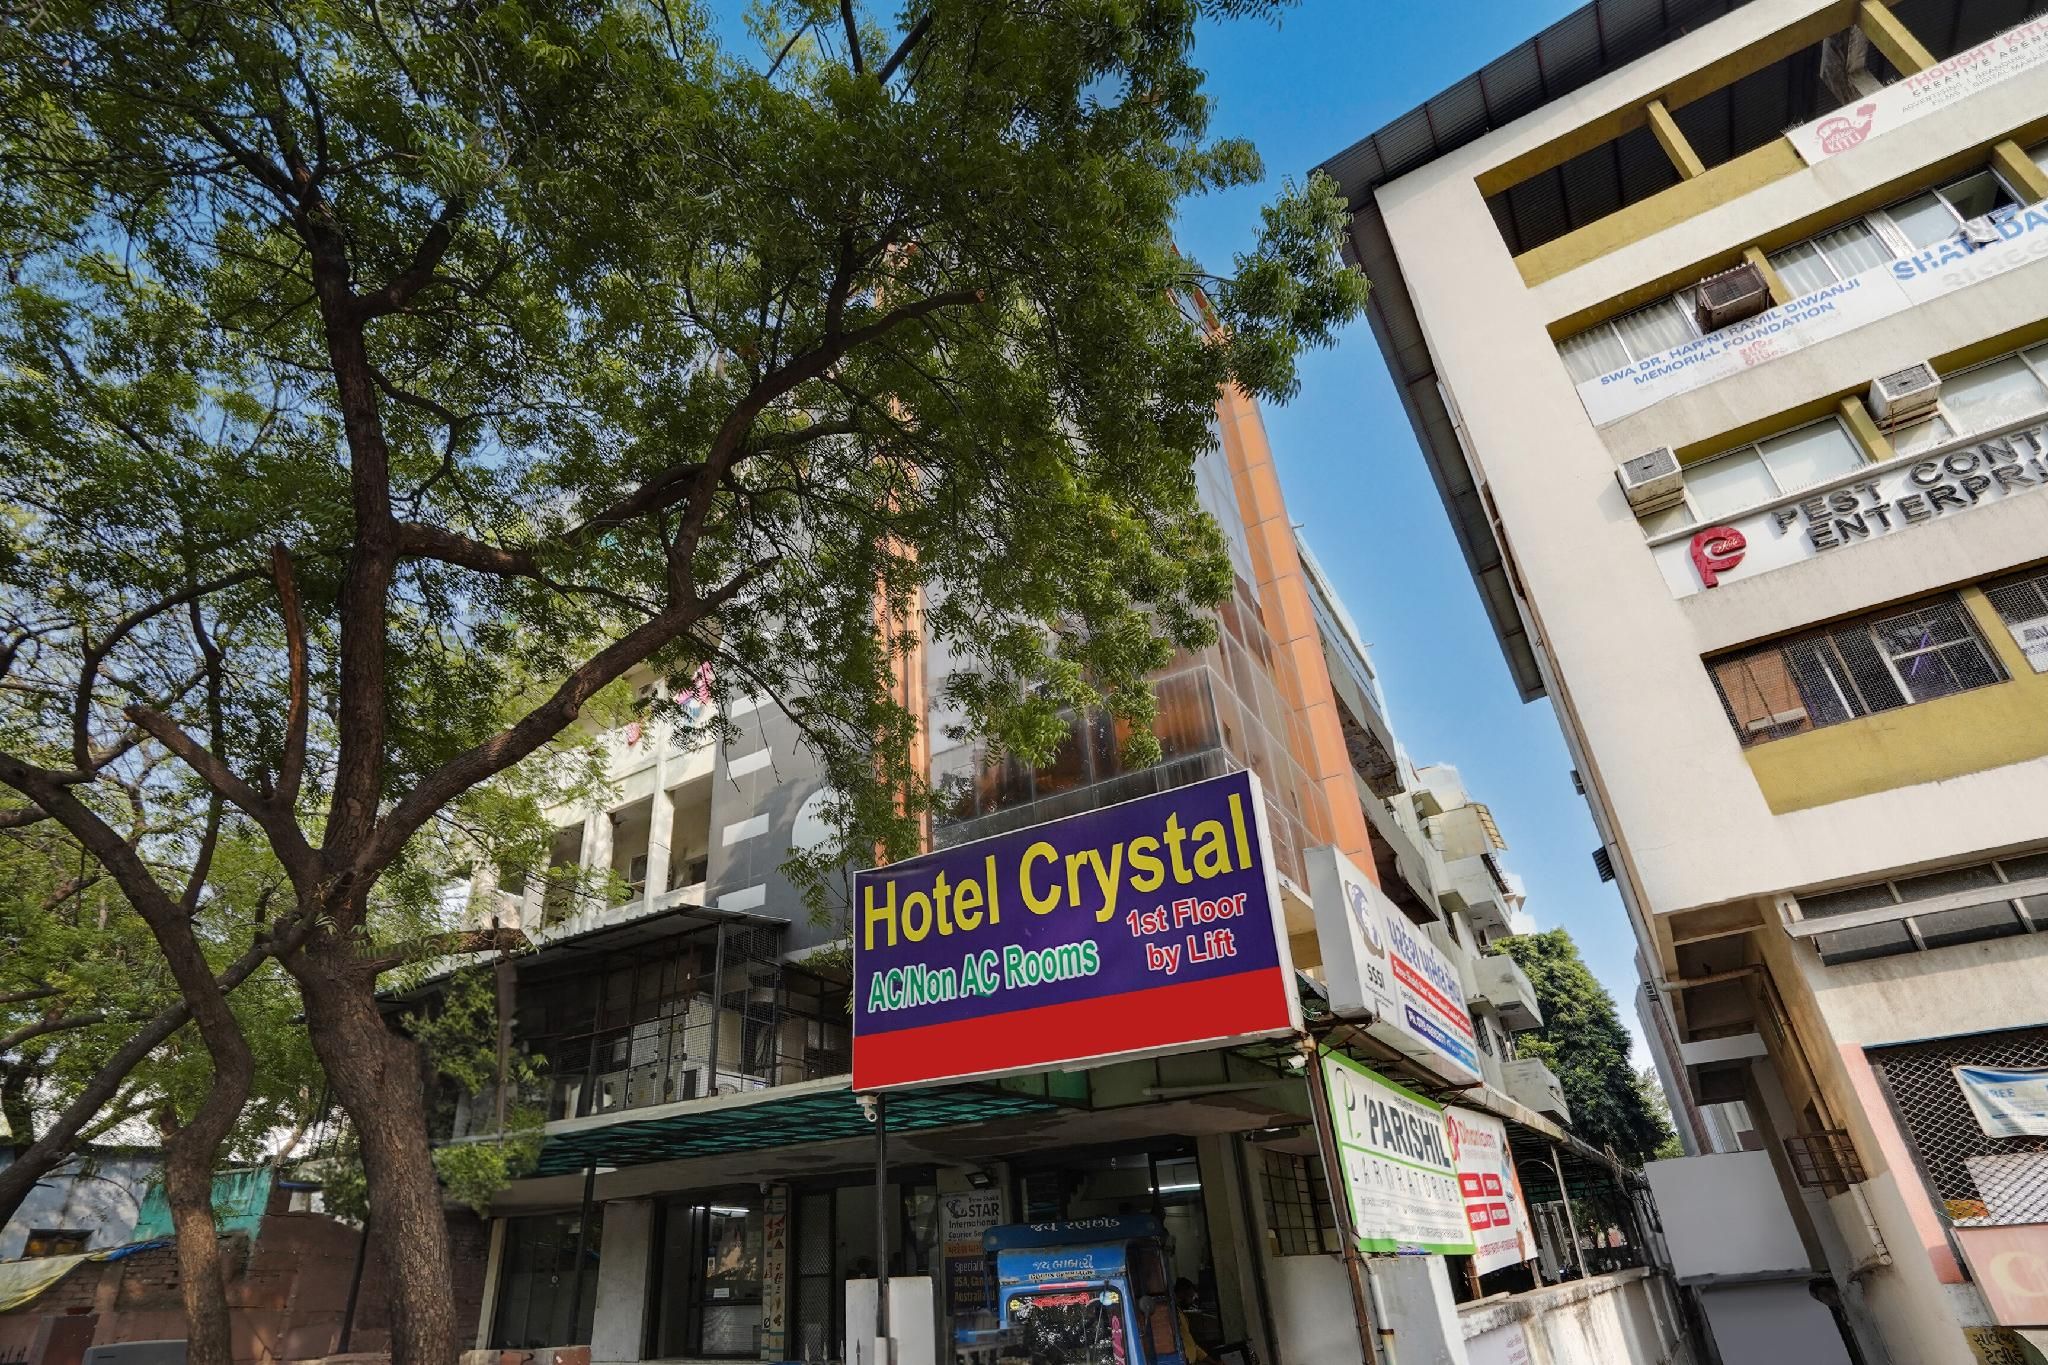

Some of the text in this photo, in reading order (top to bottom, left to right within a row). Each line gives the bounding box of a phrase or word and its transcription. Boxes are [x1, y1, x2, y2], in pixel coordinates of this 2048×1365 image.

[1906, 42, 1997, 91] THOUGHT
[1912, 59, 1991, 97] CREATIVE
[1600, 367, 1636, 385] SWA
[1639, 356, 1666, 371] DR.
[1784, 279, 1860, 313] DIWANJI
[1723, 302, 1835, 350] FOUNDATION
[1771, 423, 2048, 534] PEST CONT
[1806, 453, 2048, 552] ENTERPRI
[864, 793, 1253, 951] Hotel Crystal
[1127, 893, 1247, 937] 1st Floor
[1146, 928, 1237, 975] by Lift
[868, 940, 1100, 1013] AC/Non AC Rooms
[949, 1218, 998, 1229] International
[968, 1202, 999, 1218] STAR
[948, 1231, 972, 1240] Courier
[954, 1261, 979, 1272] Special
